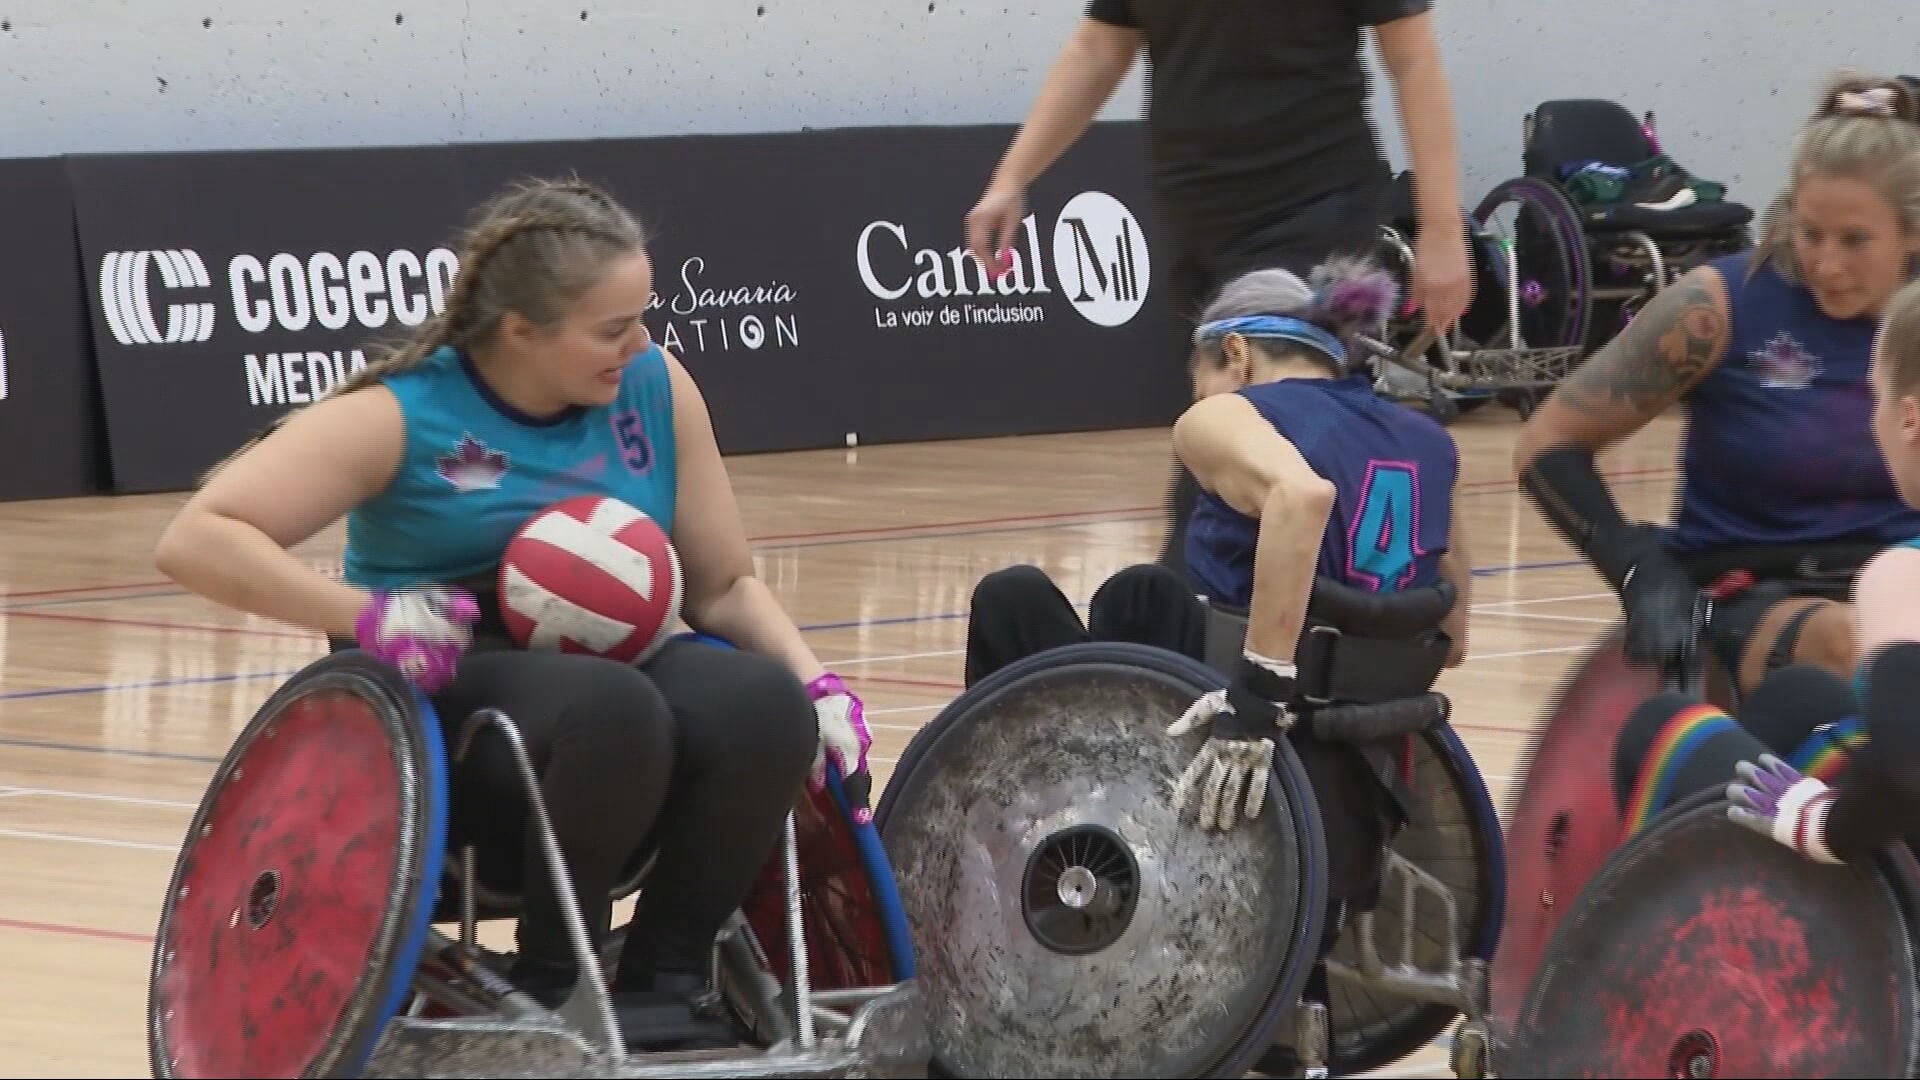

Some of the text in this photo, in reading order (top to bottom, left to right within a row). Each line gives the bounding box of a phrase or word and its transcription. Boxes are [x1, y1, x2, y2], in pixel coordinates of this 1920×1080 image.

[671, 256, 797, 315] Savaria
[857, 212, 1051, 300] Canal
[875, 307, 898, 328] La
[940, 305, 960, 325] de
[964, 302, 1044, 324] l'inclusion
[612, 410, 654, 475] 5
[1346, 460, 1426, 592] 4
